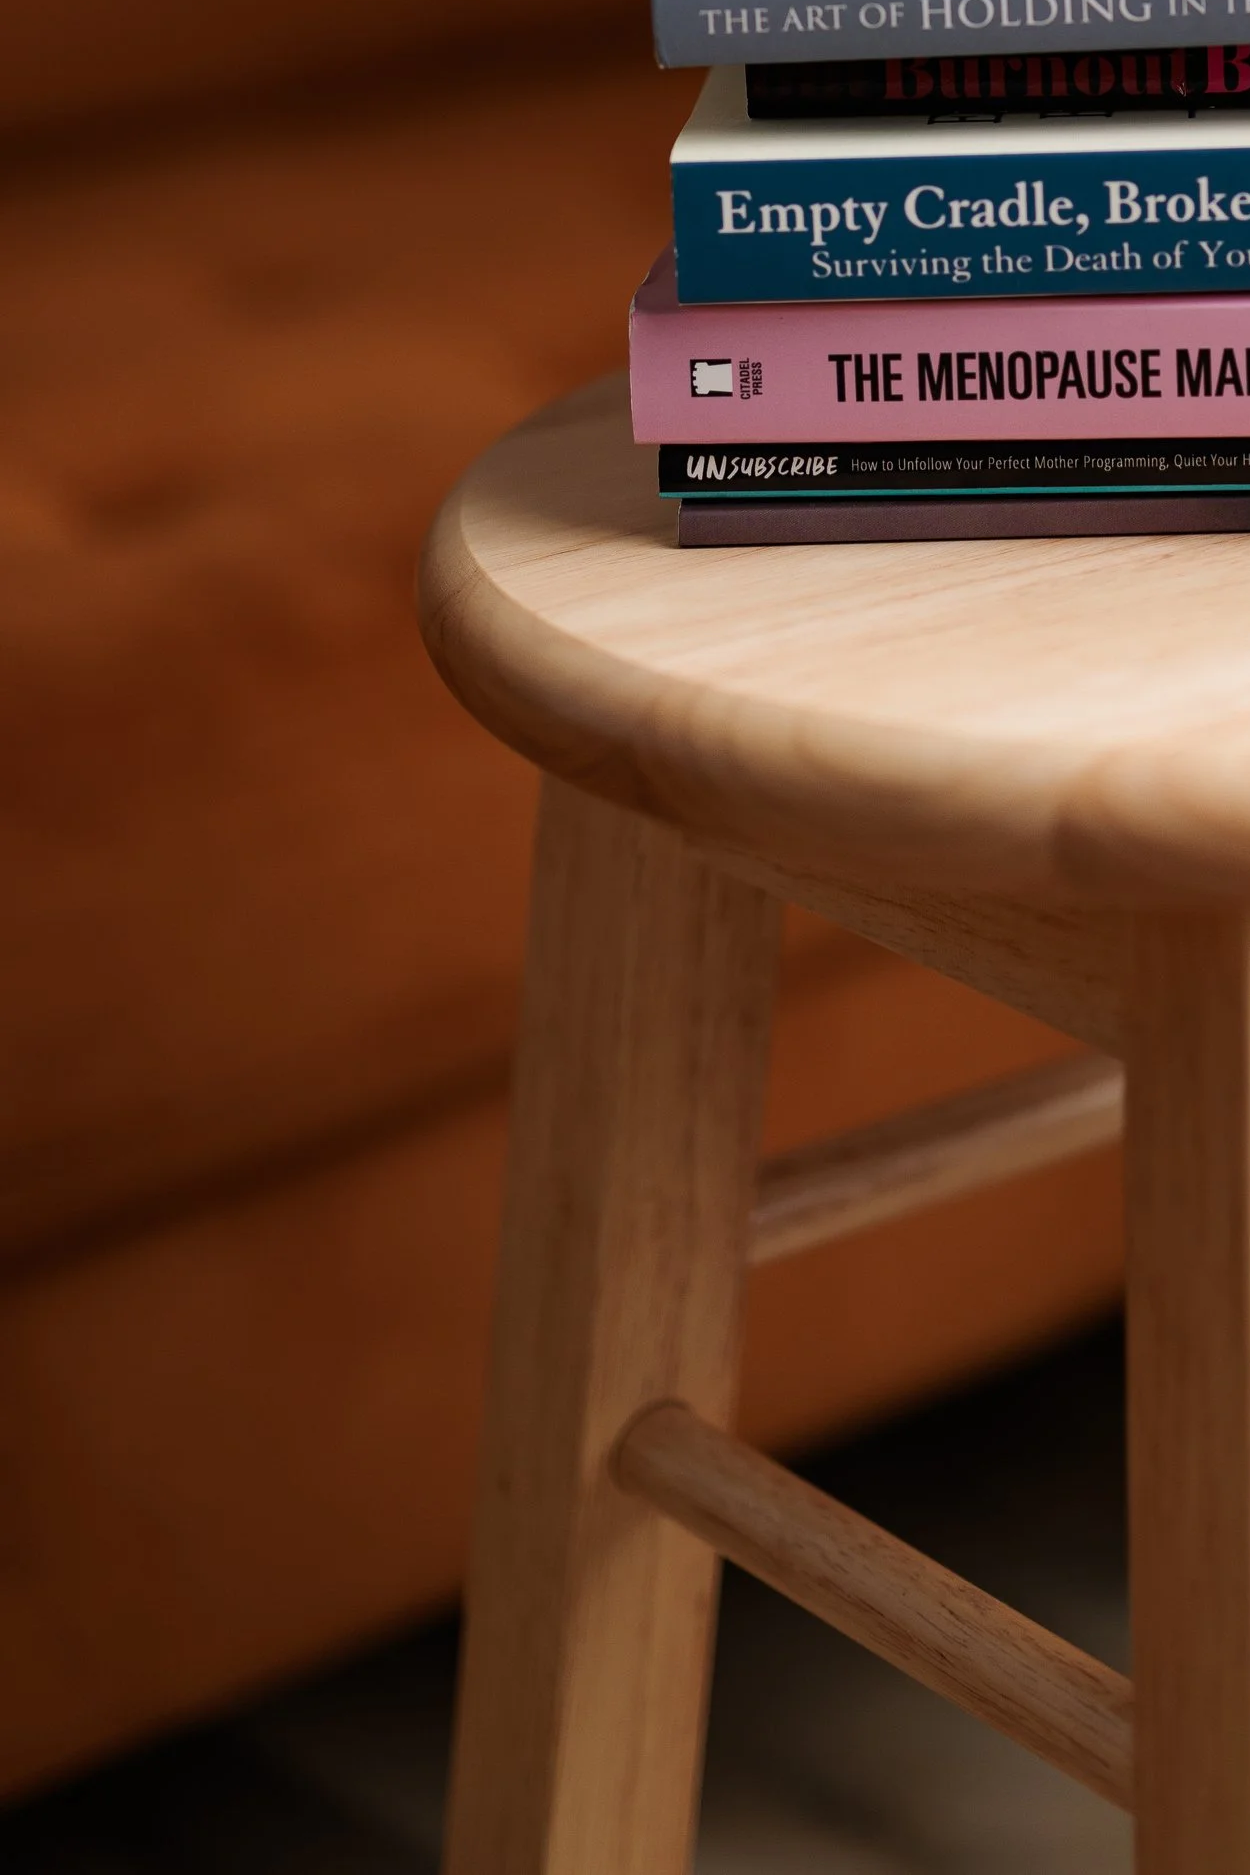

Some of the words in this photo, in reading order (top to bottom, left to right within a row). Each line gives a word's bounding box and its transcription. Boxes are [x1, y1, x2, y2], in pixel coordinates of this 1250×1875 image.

[699, 7, 771, 35] THE
[781, 3, 848, 33] ART
[858, 1, 905, 29] OF
[883, 47, 1195, 100] Burnout
[716, 190, 889, 246] Empty
[904, 180, 1090, 236] Cradle,
[812, 247, 972, 283] Surviving
[982, 245, 1033, 275] the
[1045, 241, 1143, 273] Death
[1152, 239, 1189, 269] of
[739, 357, 751, 400] CITADEL
[751, 361, 763, 396] PRESS
[828, 352, 904, 403] THE
[917, 348, 1162, 402] MENOPAUSE
[686, 454, 840, 481] UNSUBSCRIBE
[850, 458, 877, 473] How
[881, 459, 894, 472] to
[898, 456, 952, 472] Unfollow
[956, 456, 983, 471] Your
[988, 455, 1031, 471] Perfect
[1034, 455, 1079, 470] Mother
[1083, 454, 1170, 472] Programming,
[1173, 453, 1207, 469] Quiet
[1210, 453, 1238, 468] Your
